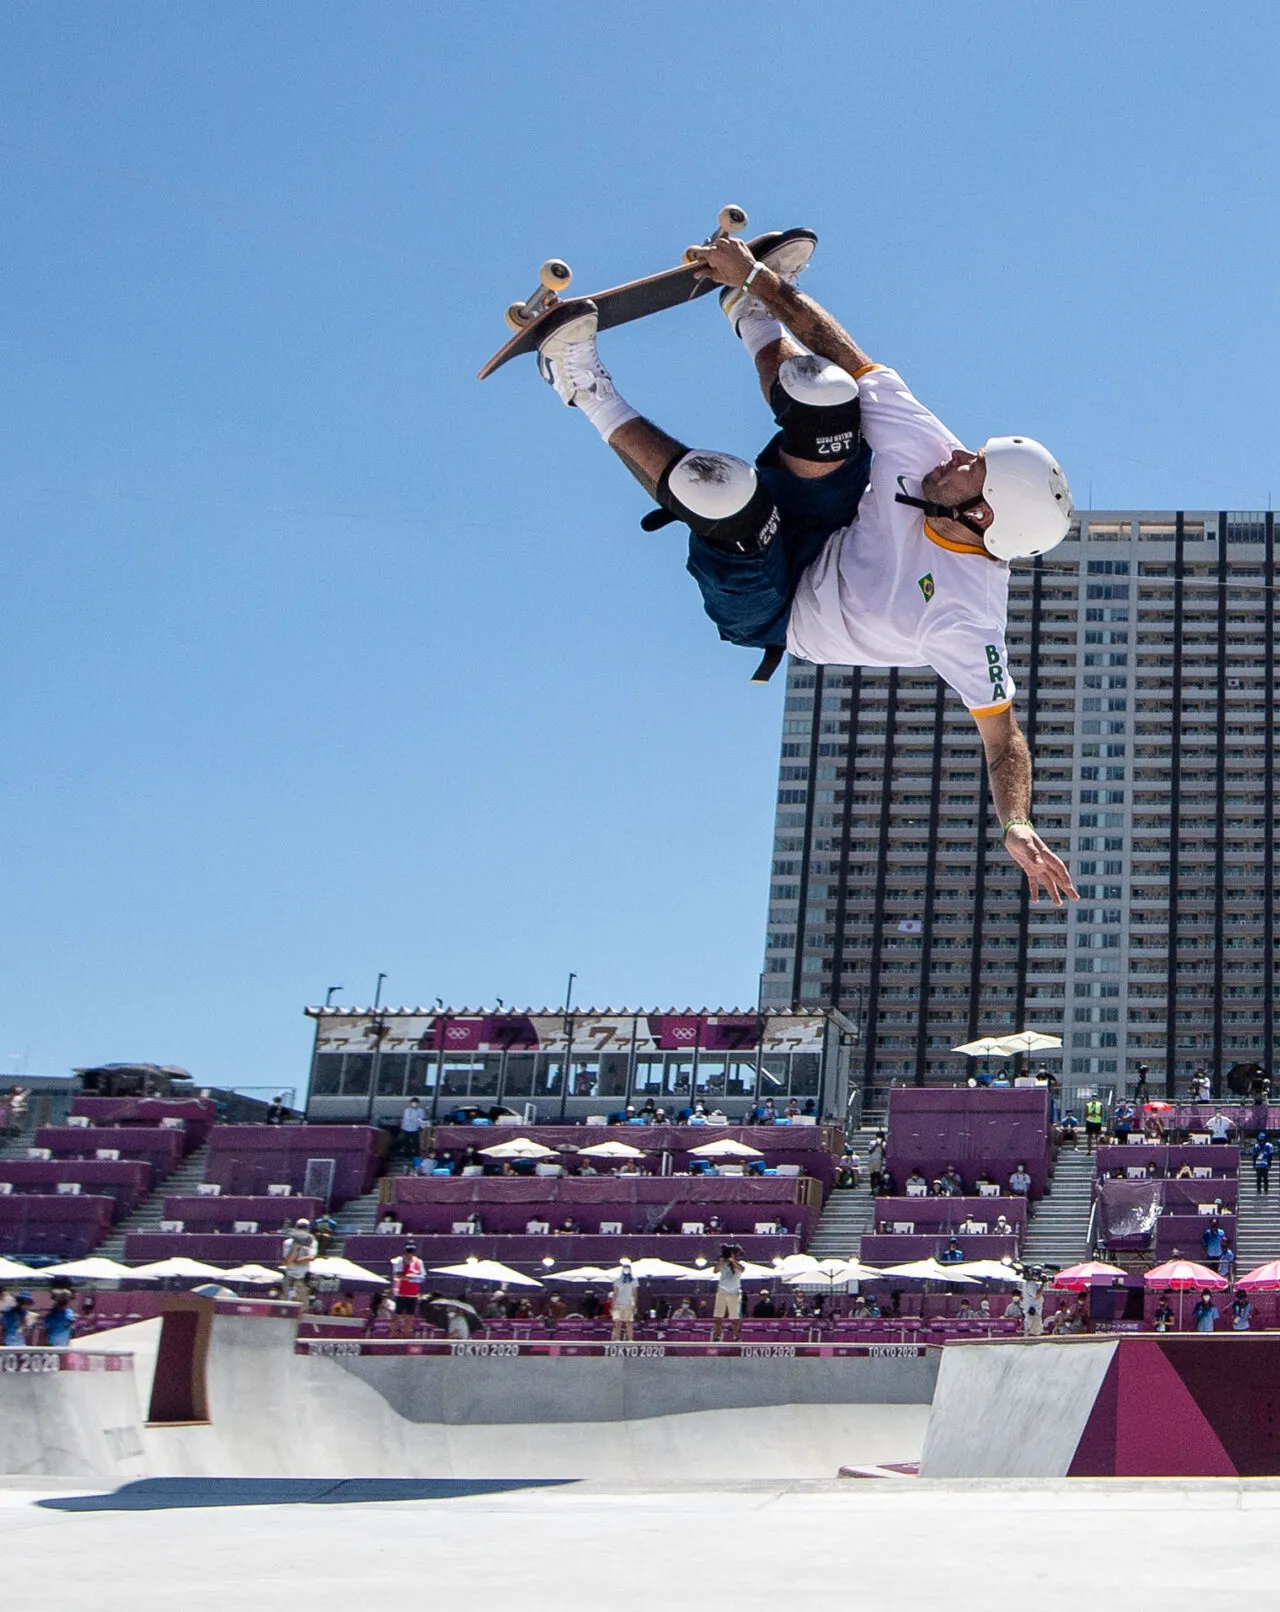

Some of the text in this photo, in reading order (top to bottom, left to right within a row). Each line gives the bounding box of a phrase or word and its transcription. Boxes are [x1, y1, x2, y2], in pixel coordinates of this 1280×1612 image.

[818, 439, 850, 454] 187
[985, 644, 1007, 702] BRA
[450, 1343, 519, 1357] TOKYO 2020
[603, 1345, 665, 1357] TOKYO 2020
[741, 1346, 796, 1357] TOKYO 2020
[868, 1347, 919, 1357] TOKYO 2020
